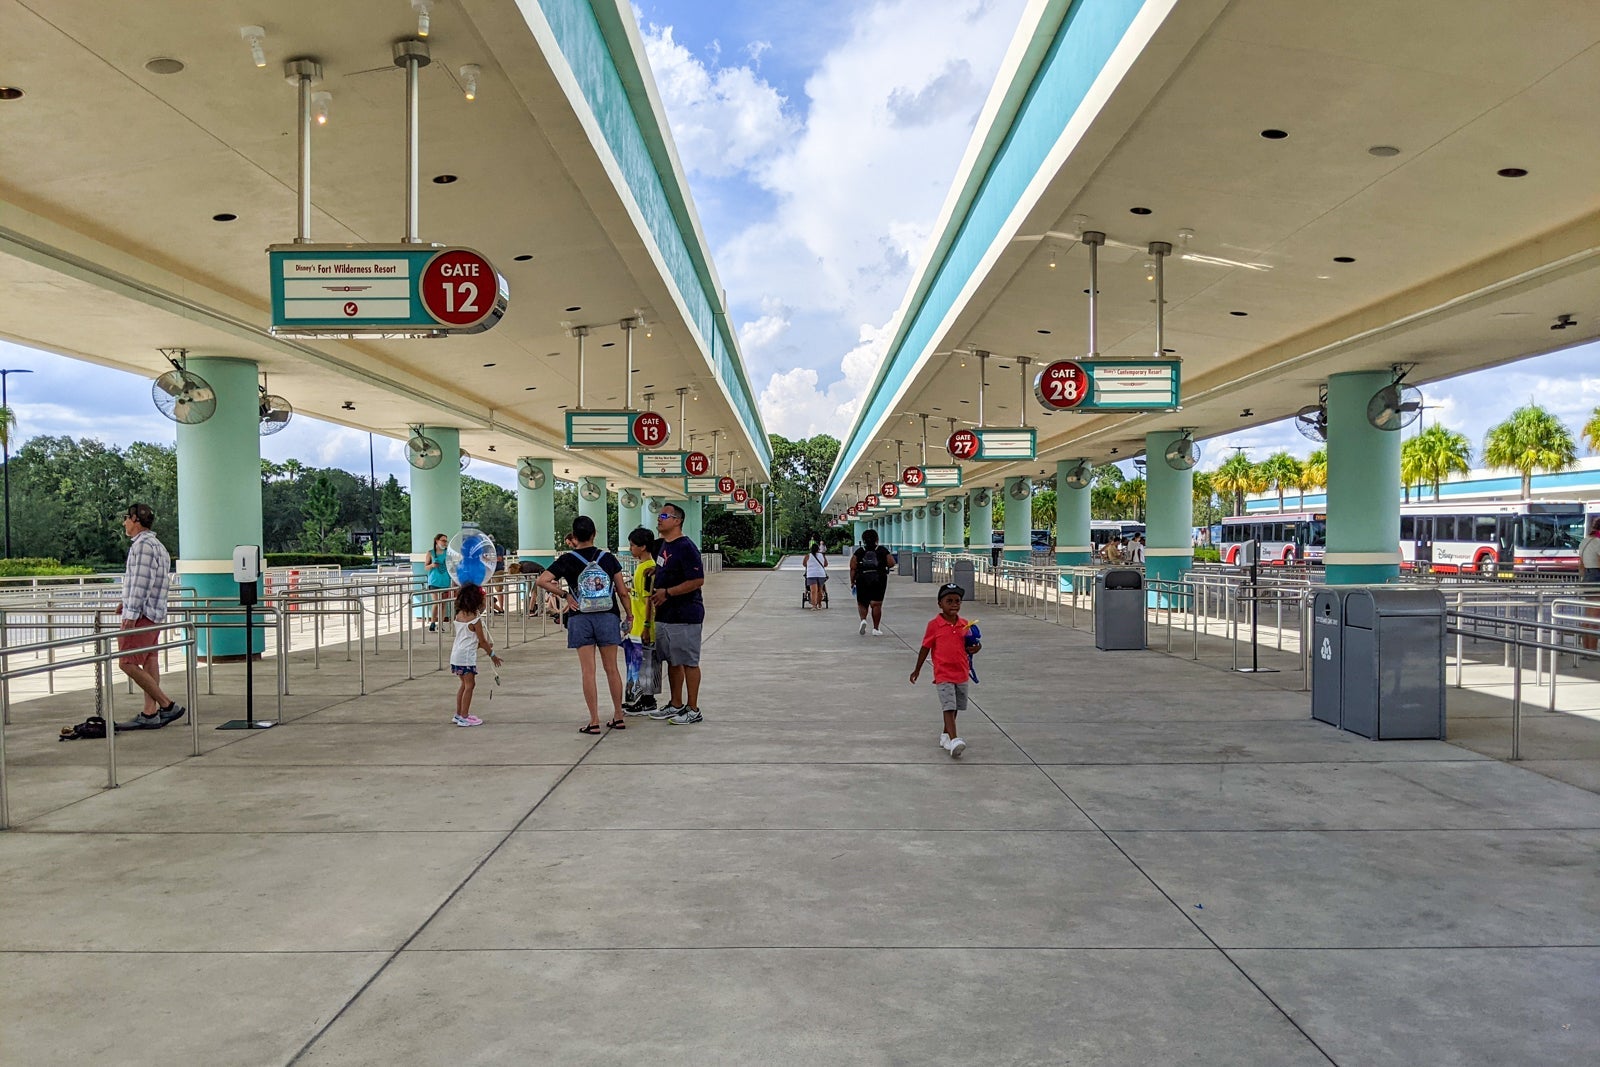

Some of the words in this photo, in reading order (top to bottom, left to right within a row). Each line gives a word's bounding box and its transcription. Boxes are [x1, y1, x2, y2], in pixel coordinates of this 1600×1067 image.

[317, 264, 332, 274] Fort
[333, 263, 372, 274] Wilderness
[374, 264, 396, 274] Resort
[440, 263, 480, 277] GATE
[441, 281, 479, 313] 12
[1051, 369, 1076, 378] GATE
[1050, 380, 1077, 400] 28
[642, 426, 659, 441] 13
[954, 441, 972, 454] 27
[691, 461, 703, 472] 14
[906, 474, 919, 483] 26
[722, 483, 731, 491] 15
